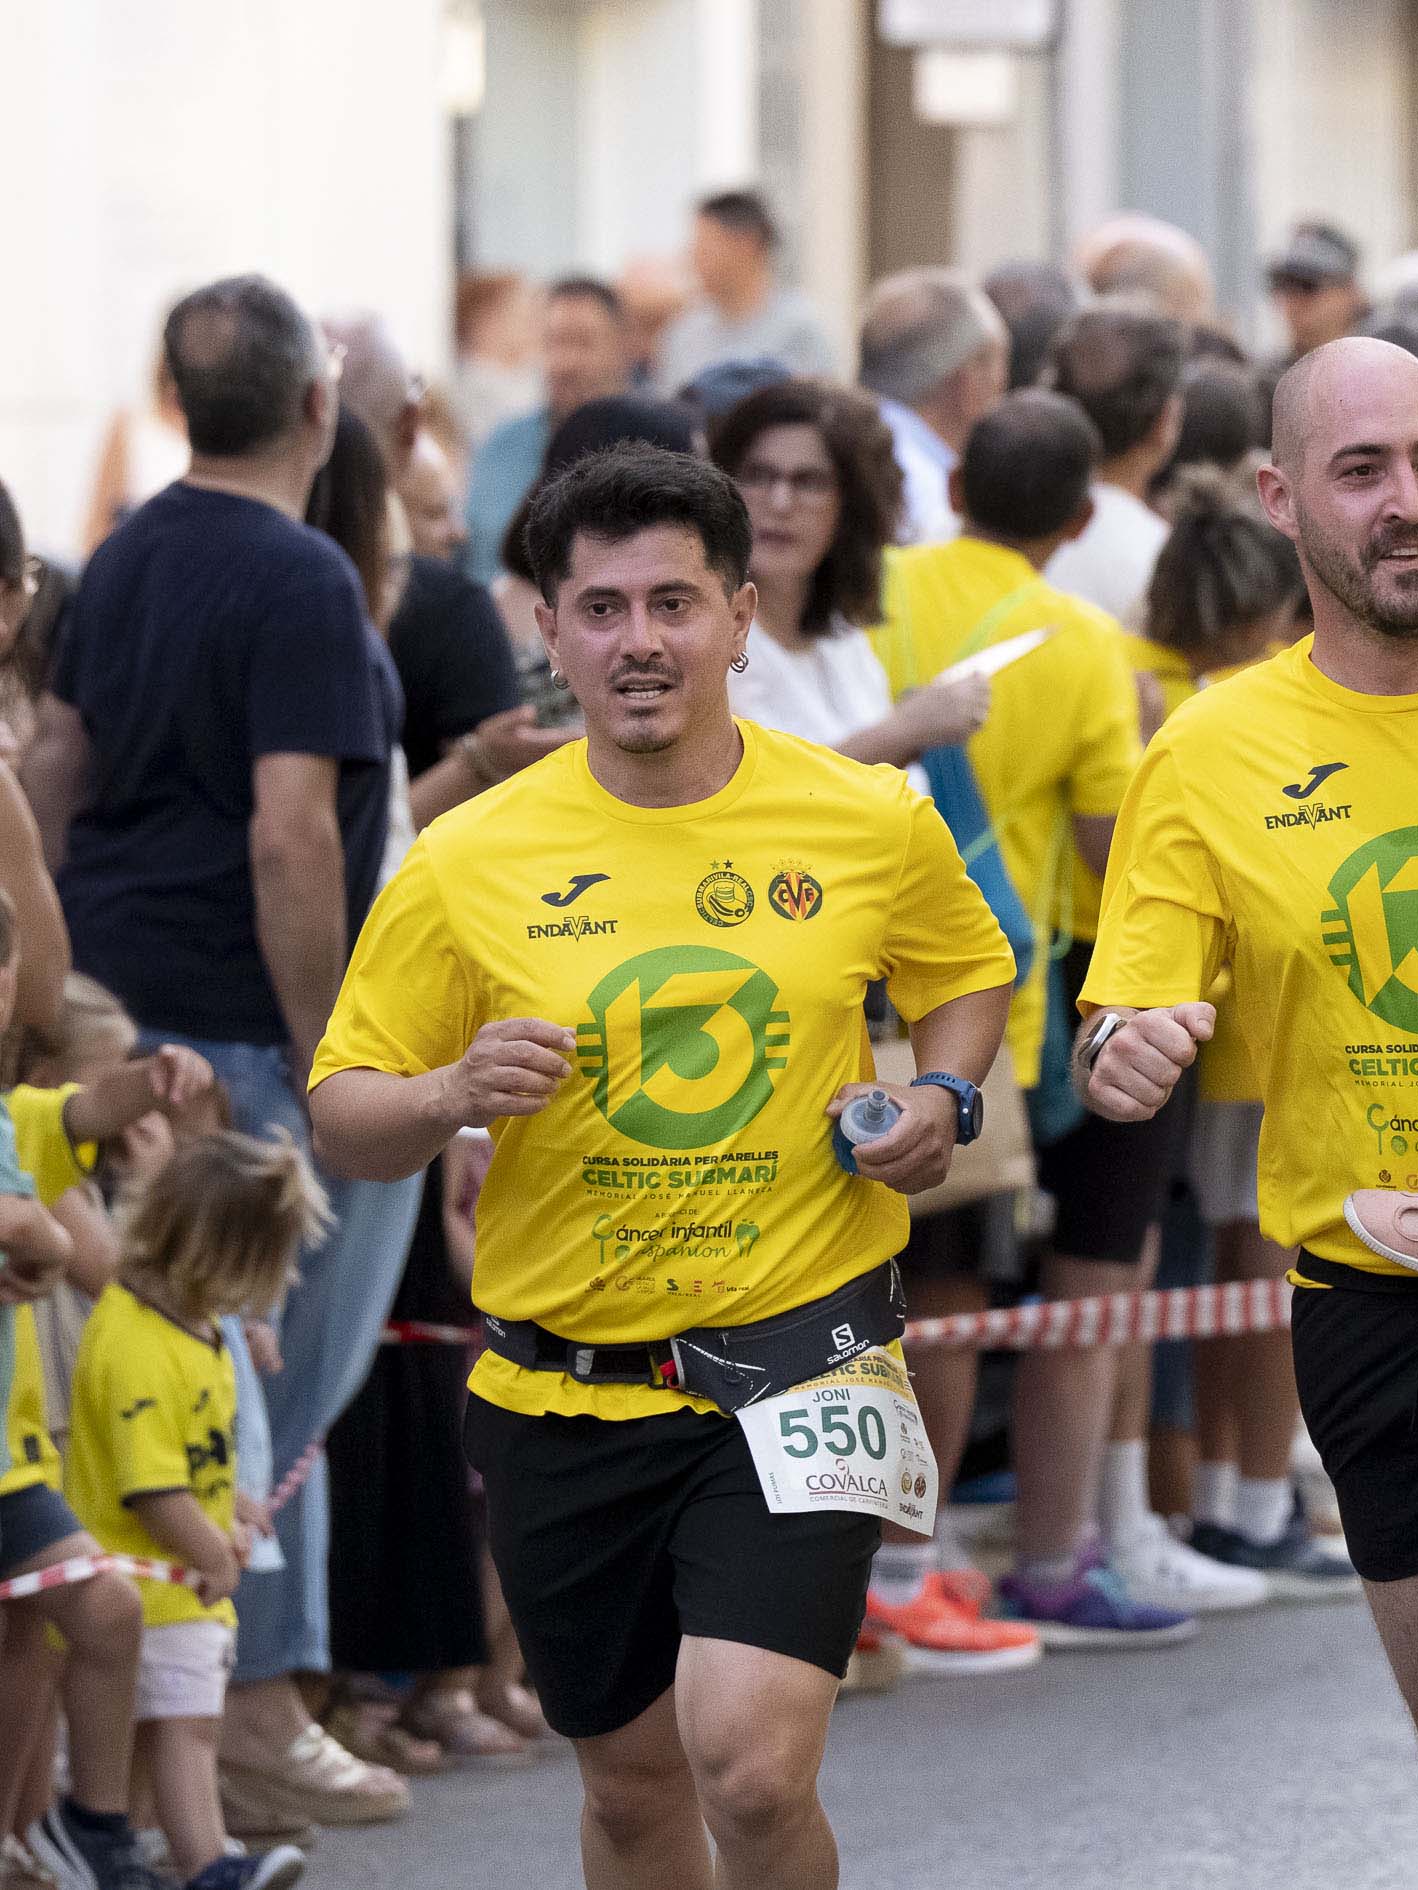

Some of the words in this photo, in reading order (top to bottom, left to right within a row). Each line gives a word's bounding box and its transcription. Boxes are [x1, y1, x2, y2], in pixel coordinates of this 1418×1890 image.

[1264, 803, 1352, 831] ENDAVANT
[527, 916, 618, 942] ENDAVANT
[604, 967, 760, 1119] 13
[1345, 1045, 1383, 1055] CURSA
[1354, 1079, 1404, 1088] MEMORIAL
[583, 1155, 619, 1166] CURSA
[622, 1152, 690, 1166] SOLIDÀRIA
[694, 1154, 718, 1165] PER
[720, 1151, 778, 1163] PARELLES
[582, 1168, 661, 1189] CELTIC
[668, 1160, 779, 1189] SUBMARÍ
[643, 1190, 671, 1200] JOSÉ
[827, 1339, 870, 1364] salomon
[812, 1388, 851, 1403] JONI
[779, 1405, 887, 1460] 550
[806, 1474, 889, 1497] COVALCA
